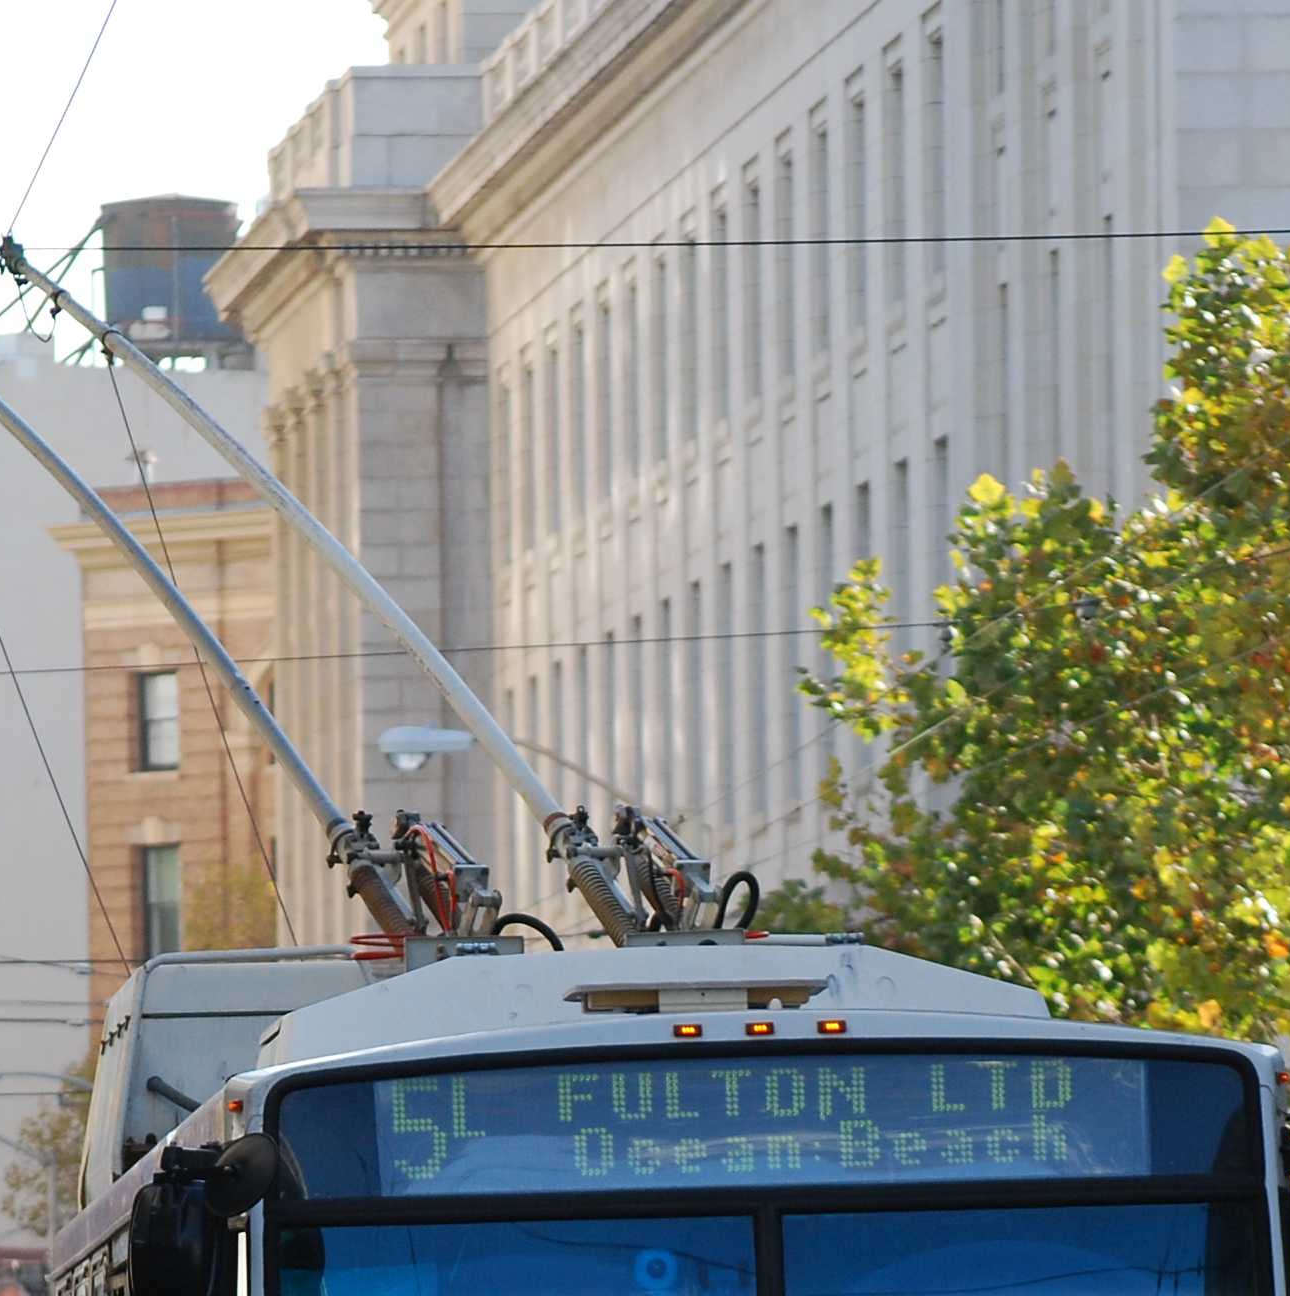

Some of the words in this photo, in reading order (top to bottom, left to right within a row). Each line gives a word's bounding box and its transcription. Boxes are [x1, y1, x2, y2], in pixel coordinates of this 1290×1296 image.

[391, 1076, 487, 1180] 5L
[557, 1065, 867, 1122] FULTON
[931, 1059, 1073, 1112] LTD
[573, 1126, 802, 1178] Ocean
[838, 1113, 1069, 1168] Beach
